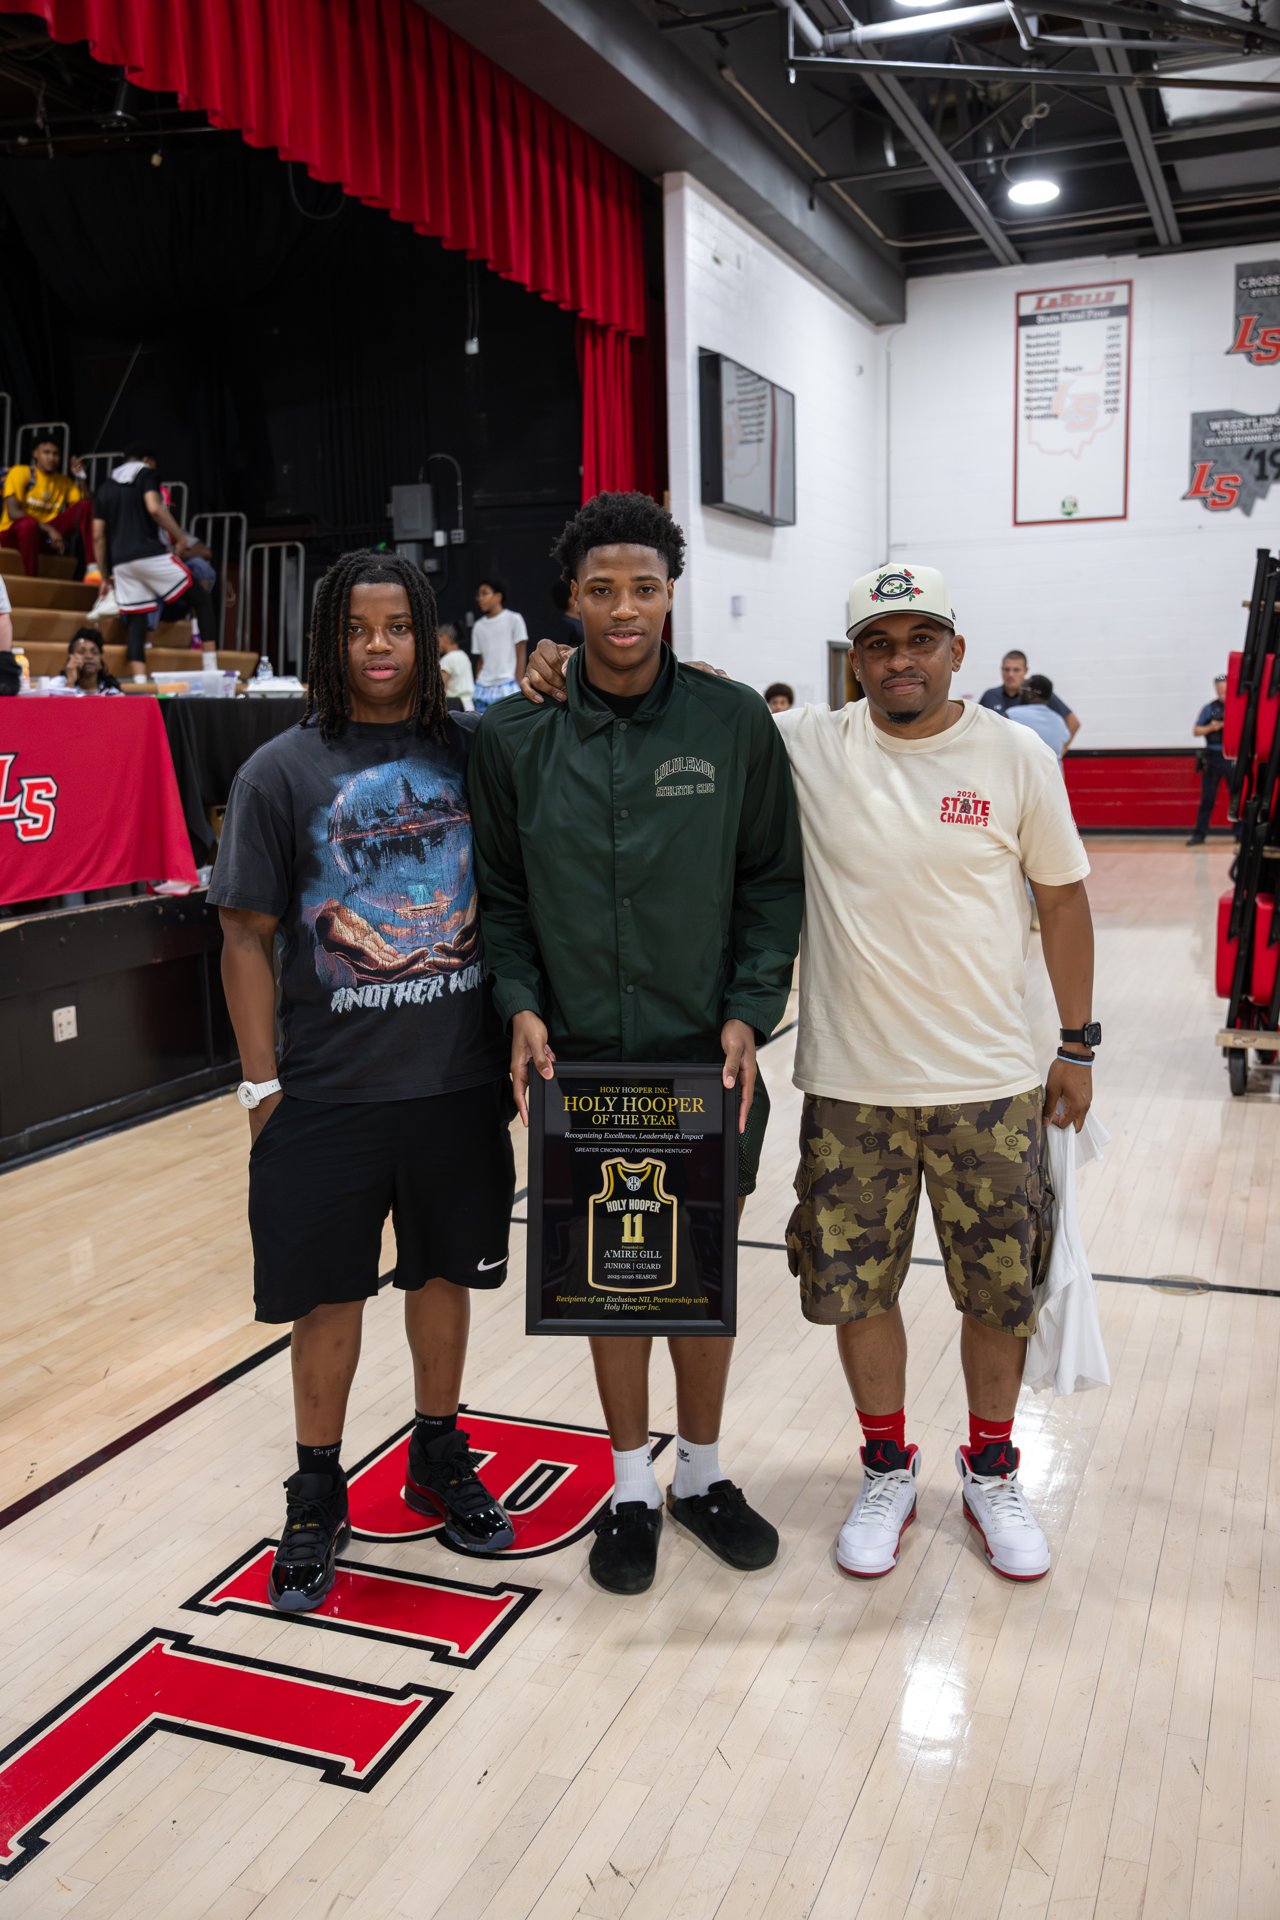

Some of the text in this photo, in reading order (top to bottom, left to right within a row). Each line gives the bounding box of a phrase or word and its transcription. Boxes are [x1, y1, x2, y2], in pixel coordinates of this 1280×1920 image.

[1238, 273, 1280, 289] CROSS
[1035, 314, 1060, 325] State
[1086, 309, 1110, 318] Four
[1227, 313, 1280, 365] LS
[1207, 415, 1280, 431] WRESTLING
[1184, 459, 1242, 510] LS
[654, 756, 716, 786] LULULEMON
[656, 782, 715, 797] ATHLETIC CLUB
[956, 790, 977, 798] 2026
[940, 796, 991, 817] STTE
[940, 812, 988, 827] CHAMPS
[330, 974, 445, 1014] ANOTHER
[600, 1086, 620, 1094] HOLY
[622, 1086, 653, 1094] HOOPER
[563, 1096, 706, 1113] HOLY HOOPER
[592, 1114, 677, 1126] OF THE YEAR
[564, 1131, 603, 1140] Recognizing
[604, 1132, 638, 1140] Excellence,
[639, 1132, 674, 1141] Leadership
[681, 1133, 704, 1141] Impact
[606, 1198, 661, 1213] HOLY HOOPER
[622, 1213, 644, 1243] 11
[604, 1250, 662, 1259] A'MIRE GILL
[604, 1262, 631, 1270] JUNIOR
[556, 1296, 588, 1304] Recipient
[588, 1296, 595, 1304] of
[652, 1296, 693, 1304] Partnership
[604, 1304, 620, 1312] Holy
[621, 1304, 647, 1312] Hooper
